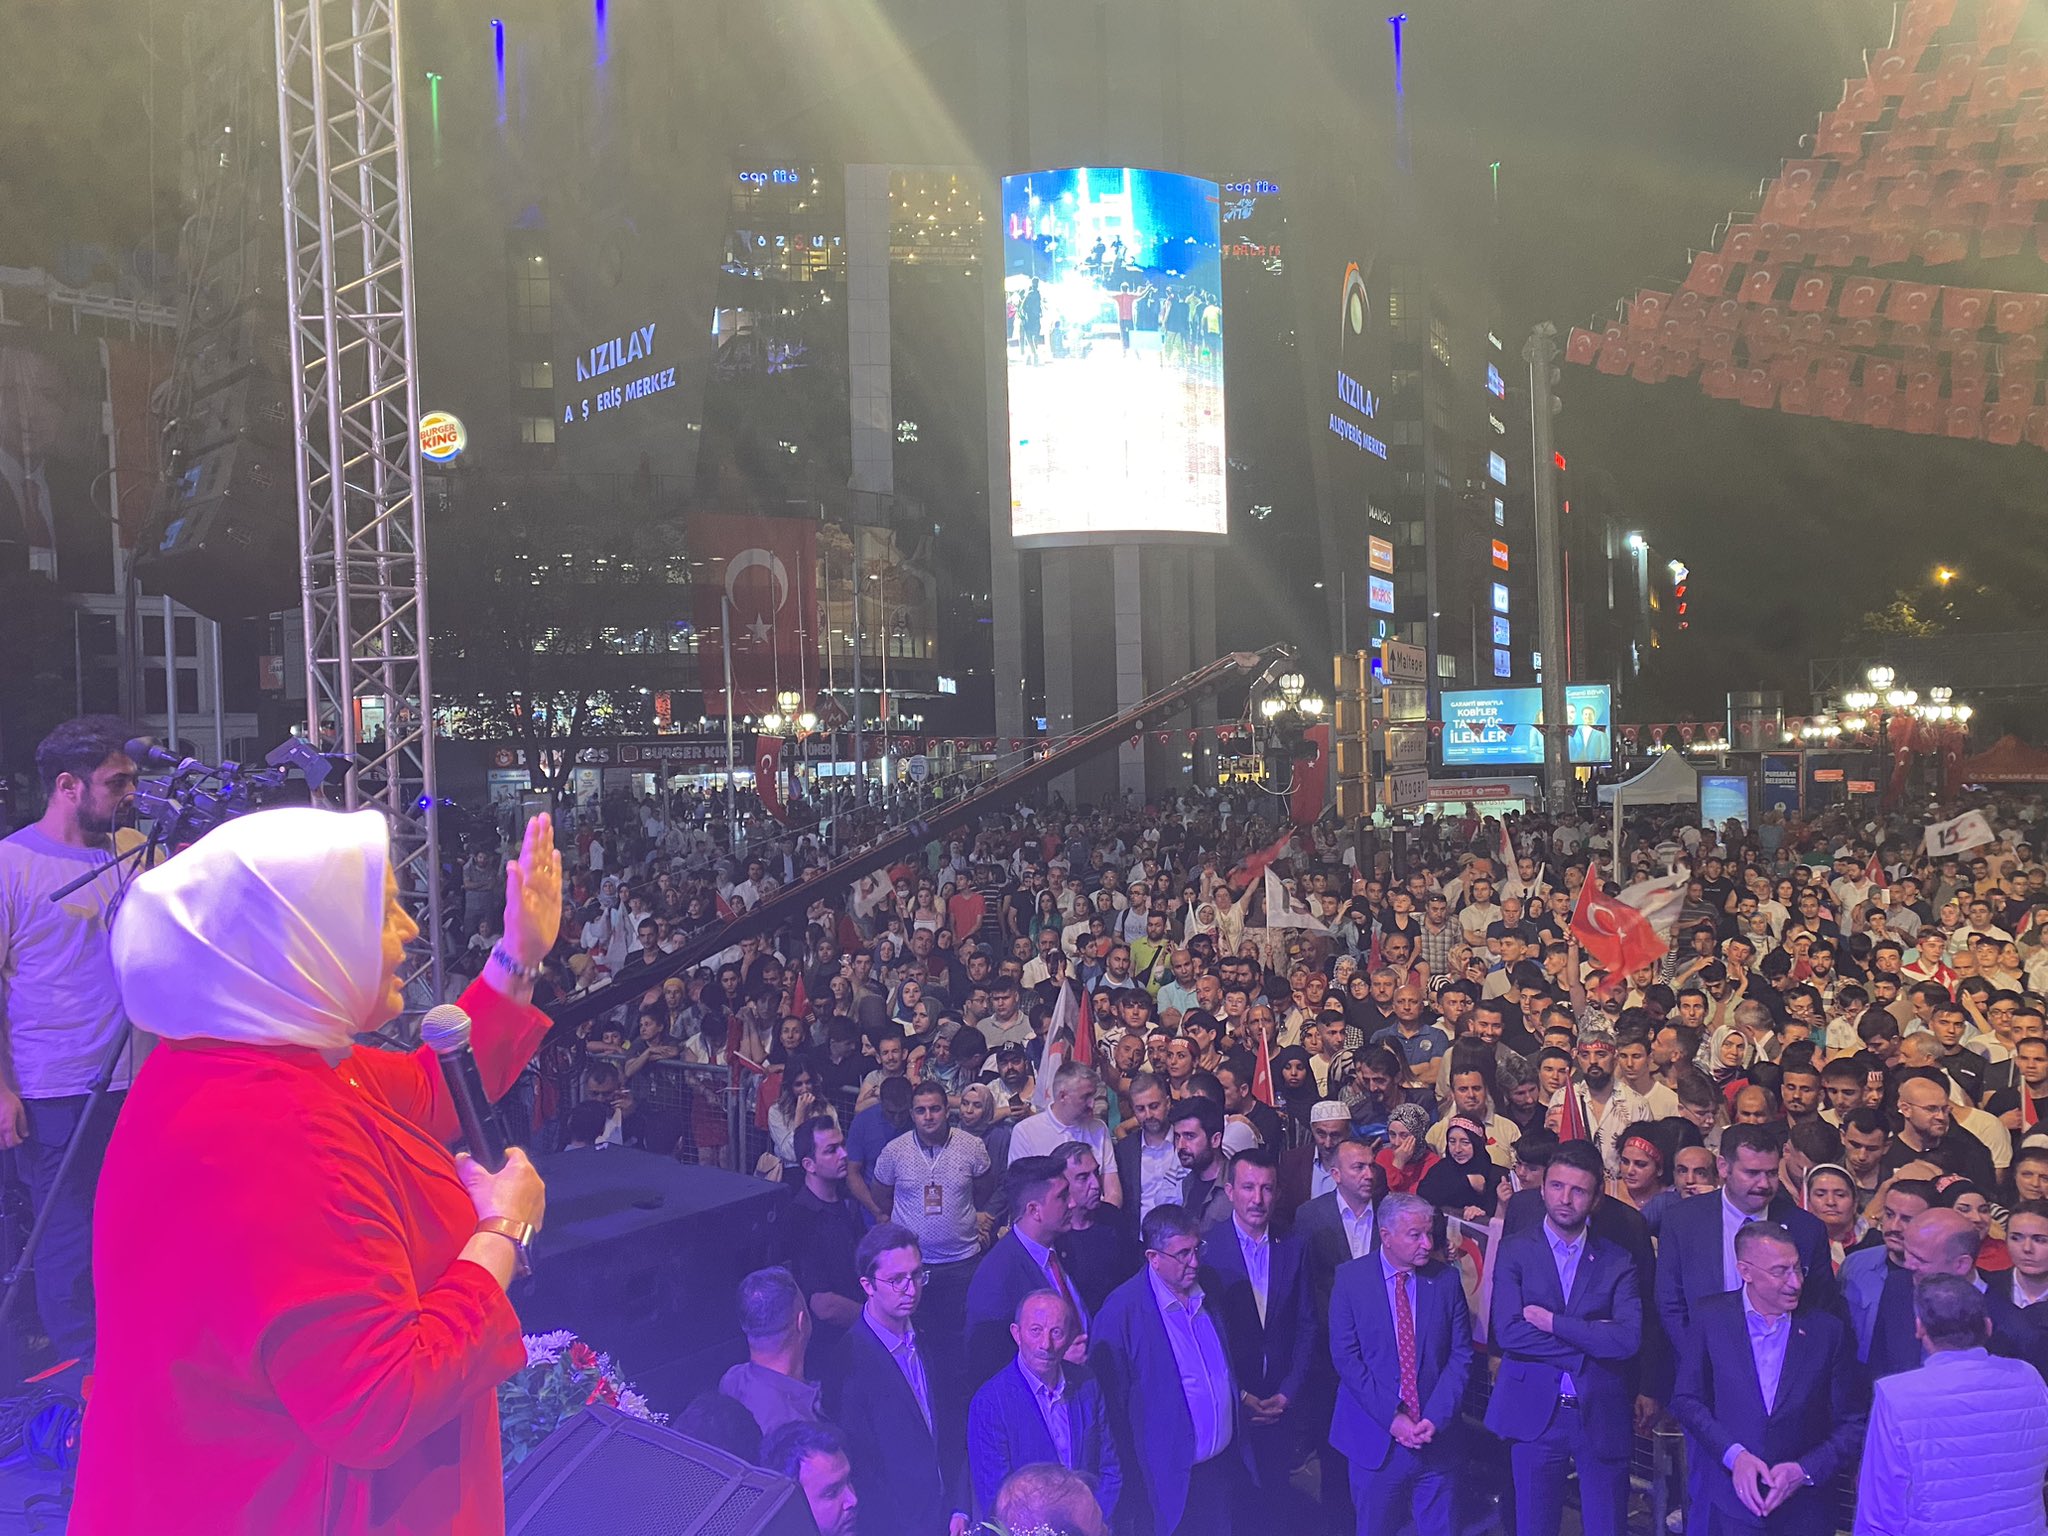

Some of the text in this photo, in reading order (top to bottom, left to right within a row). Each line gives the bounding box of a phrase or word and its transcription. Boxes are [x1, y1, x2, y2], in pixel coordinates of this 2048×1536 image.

[420, 424, 455, 440] BURGER
[422, 431, 457, 450] KING
[1368, 504, 1392, 525] MANGO
[1397, 650, 1423, 672] Maltepe
[641, 745, 702, 760] BURGER
[1400, 779, 1425, 799] Otogar
